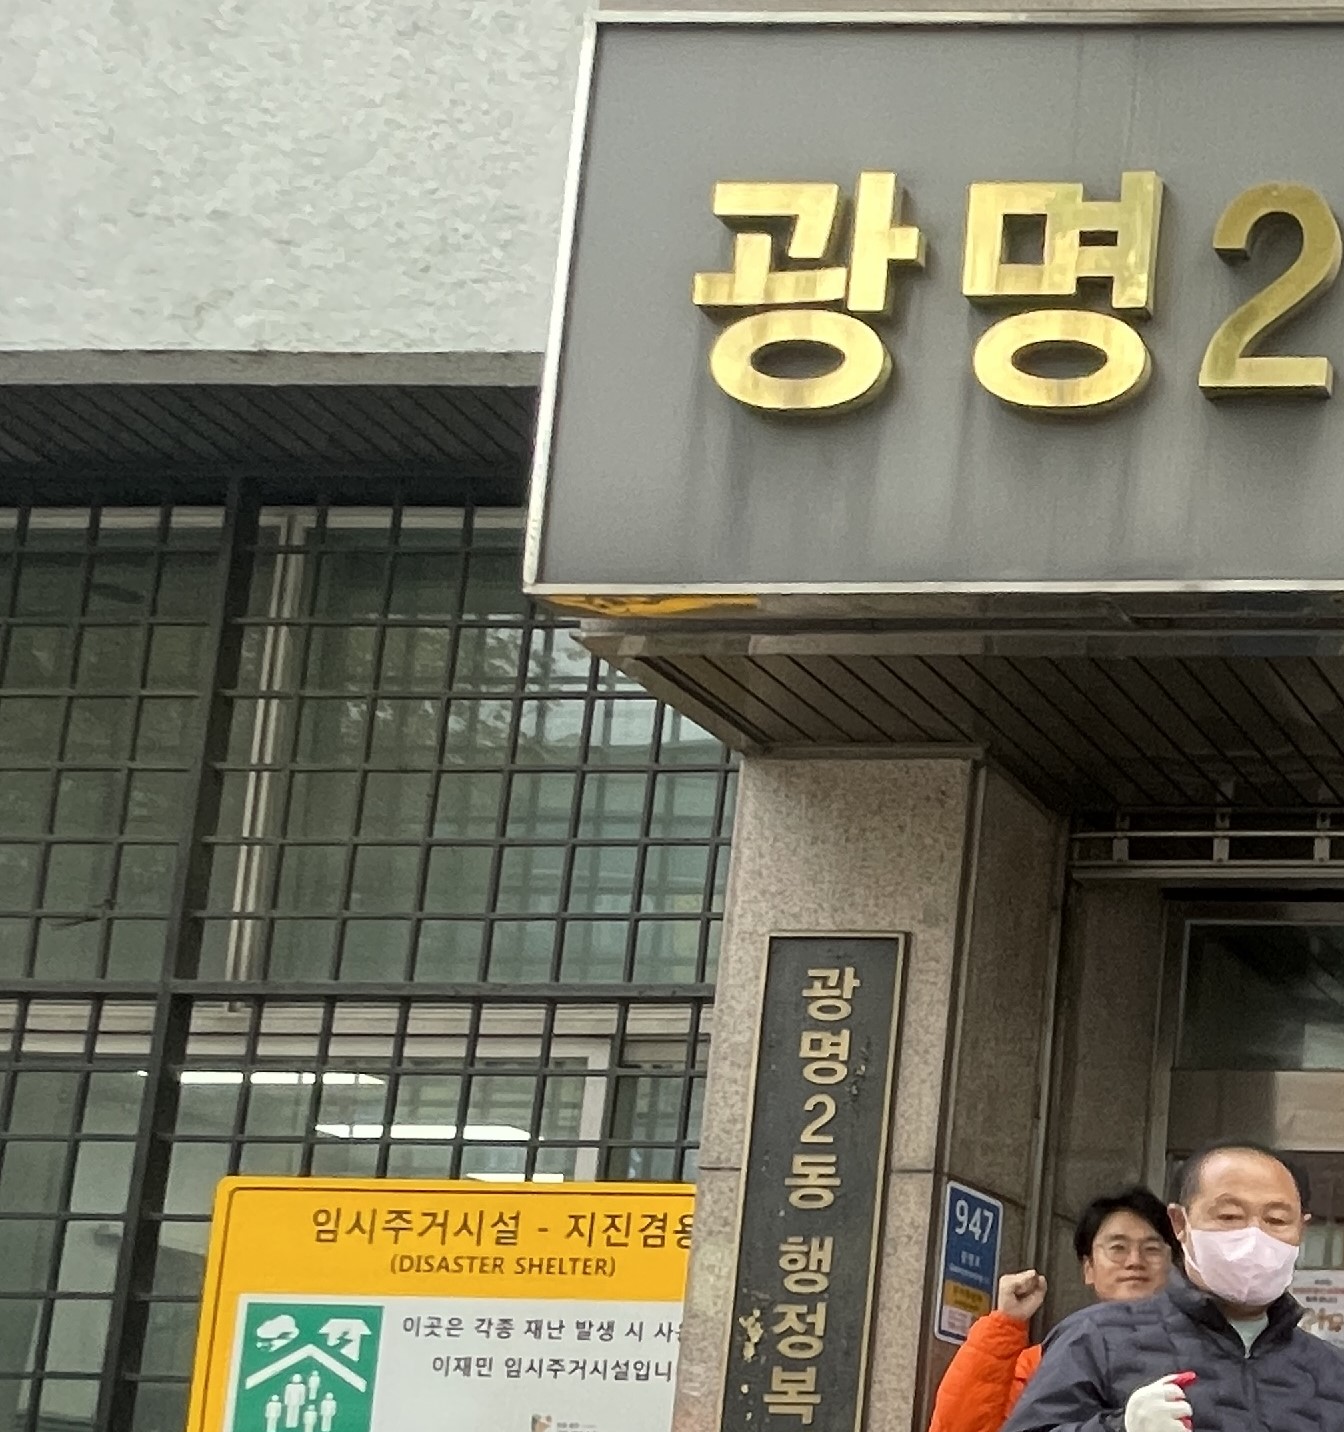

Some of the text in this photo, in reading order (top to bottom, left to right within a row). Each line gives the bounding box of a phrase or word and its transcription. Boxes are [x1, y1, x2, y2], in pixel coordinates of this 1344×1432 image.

[784, 966, 860, 1211] 광명2동
[312, 1207, 522, 1246] 임시주거시설
[955, 1200, 994, 1244] 947
[390, 1254, 617, 1278] (DISASTER SHELTER)
[402, 1316, 682, 1345] 이곳은 각종 재난 발생 시 사
[431, 1355, 494, 1379] 이재민
